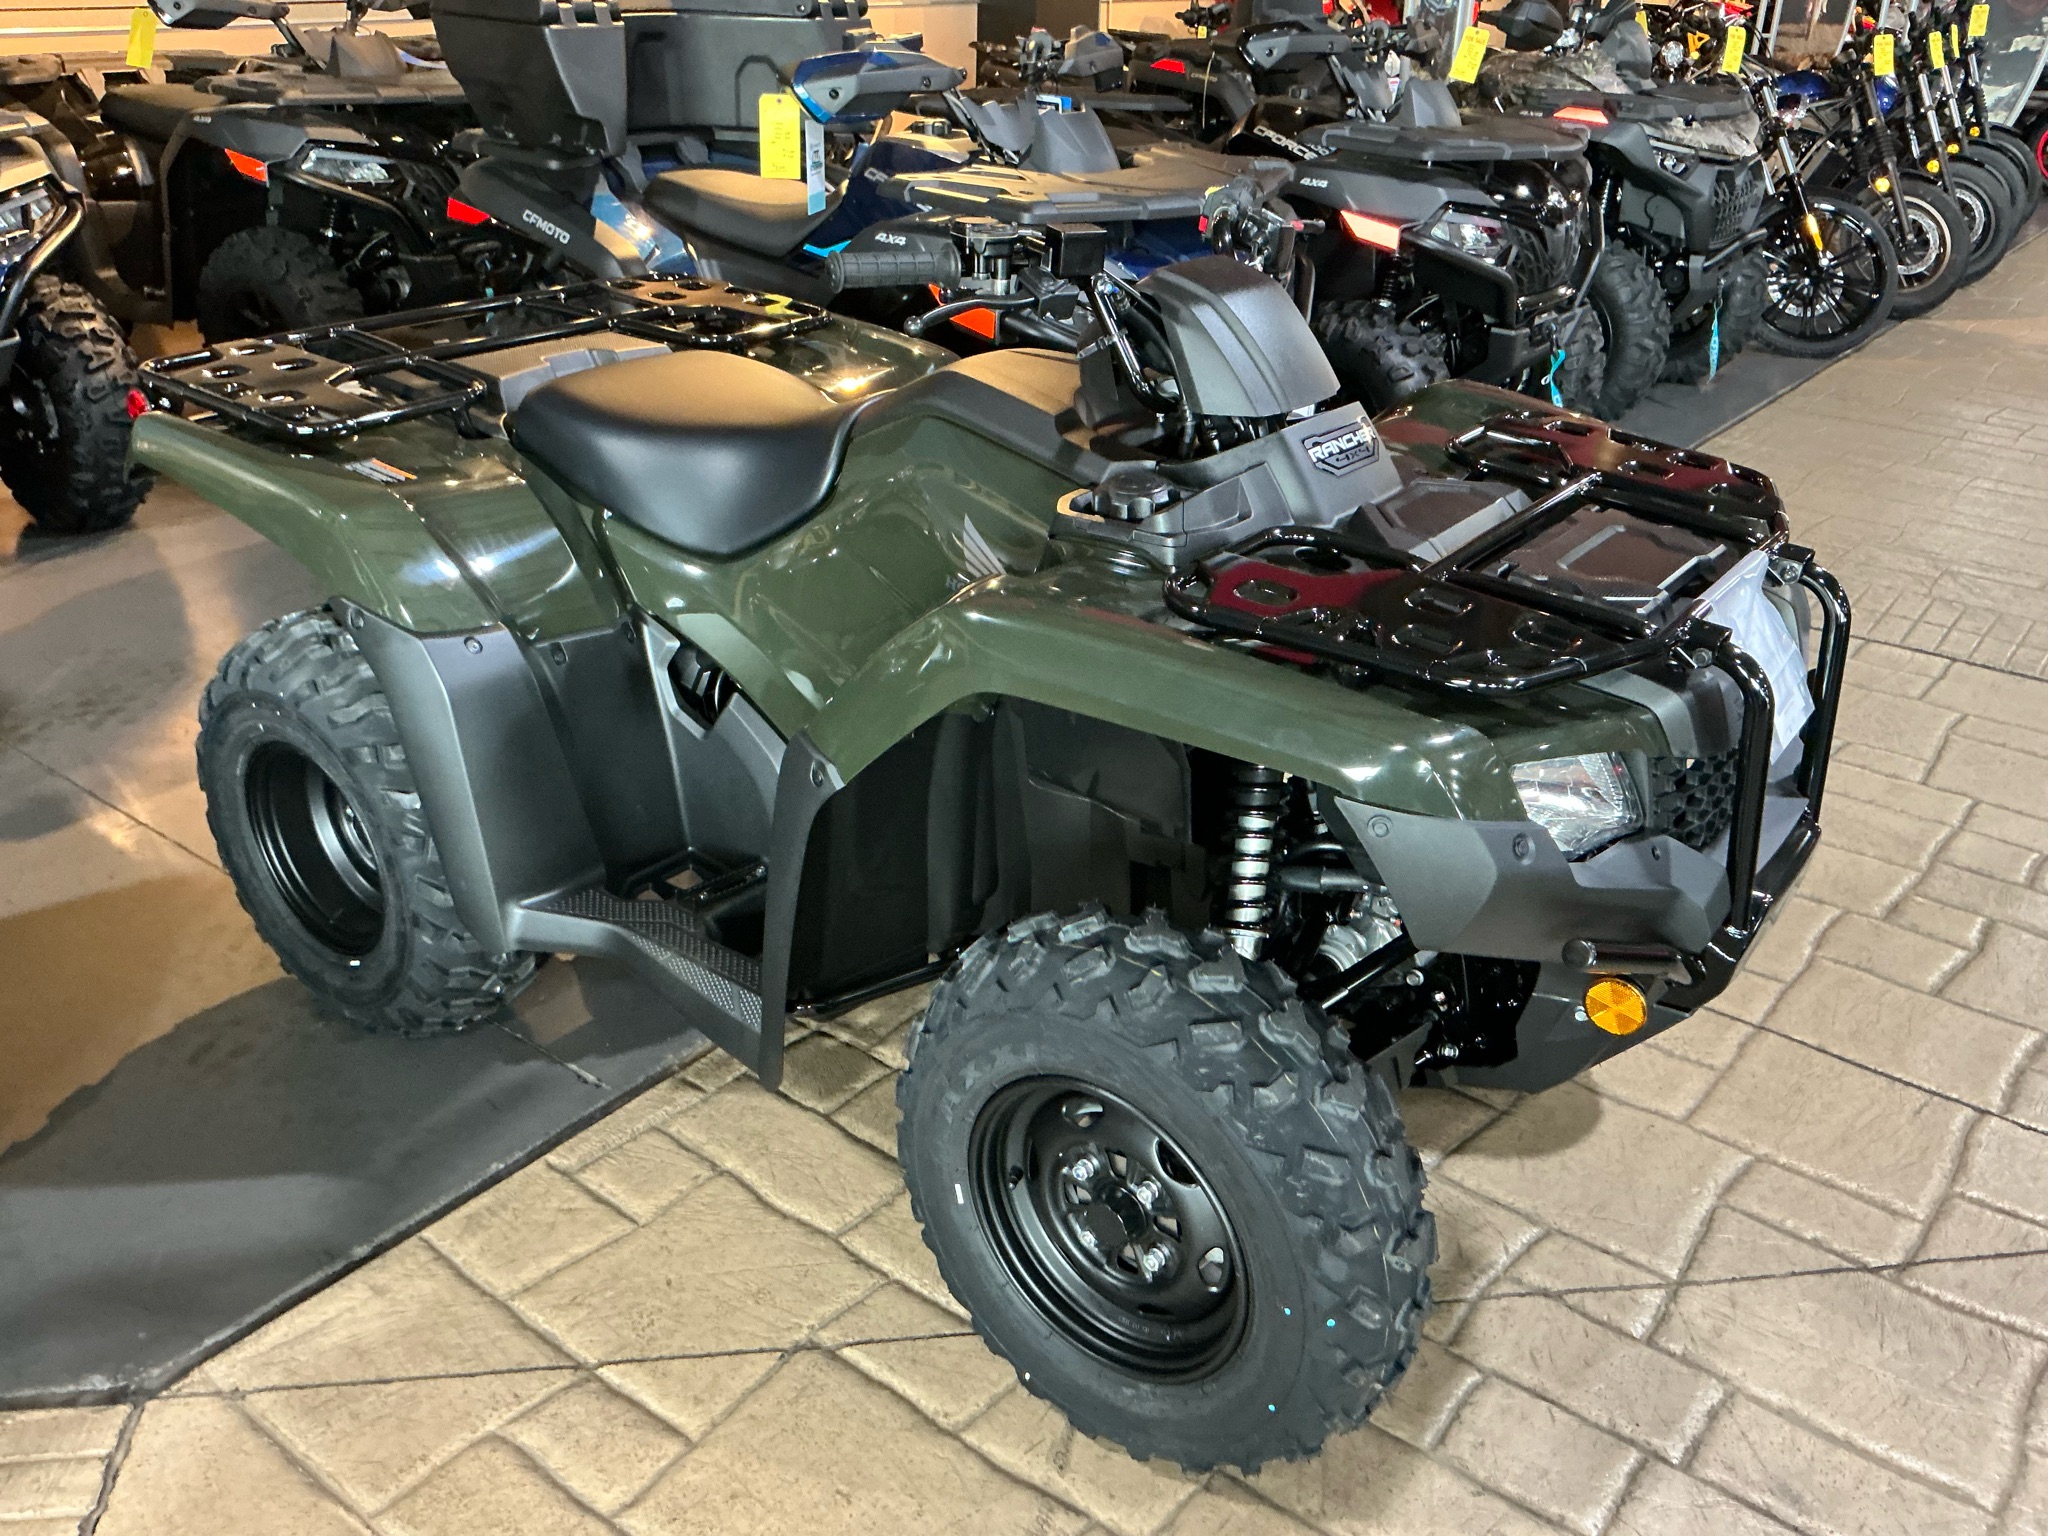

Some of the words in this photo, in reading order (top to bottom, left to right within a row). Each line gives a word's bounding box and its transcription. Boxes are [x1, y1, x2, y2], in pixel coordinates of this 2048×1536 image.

[1253, 125, 1318, 160] CFORCE
[522, 209, 570, 245] CFMOTO
[875, 232, 906, 246] 4X4
[1307, 422, 1376, 463] RANCHER
